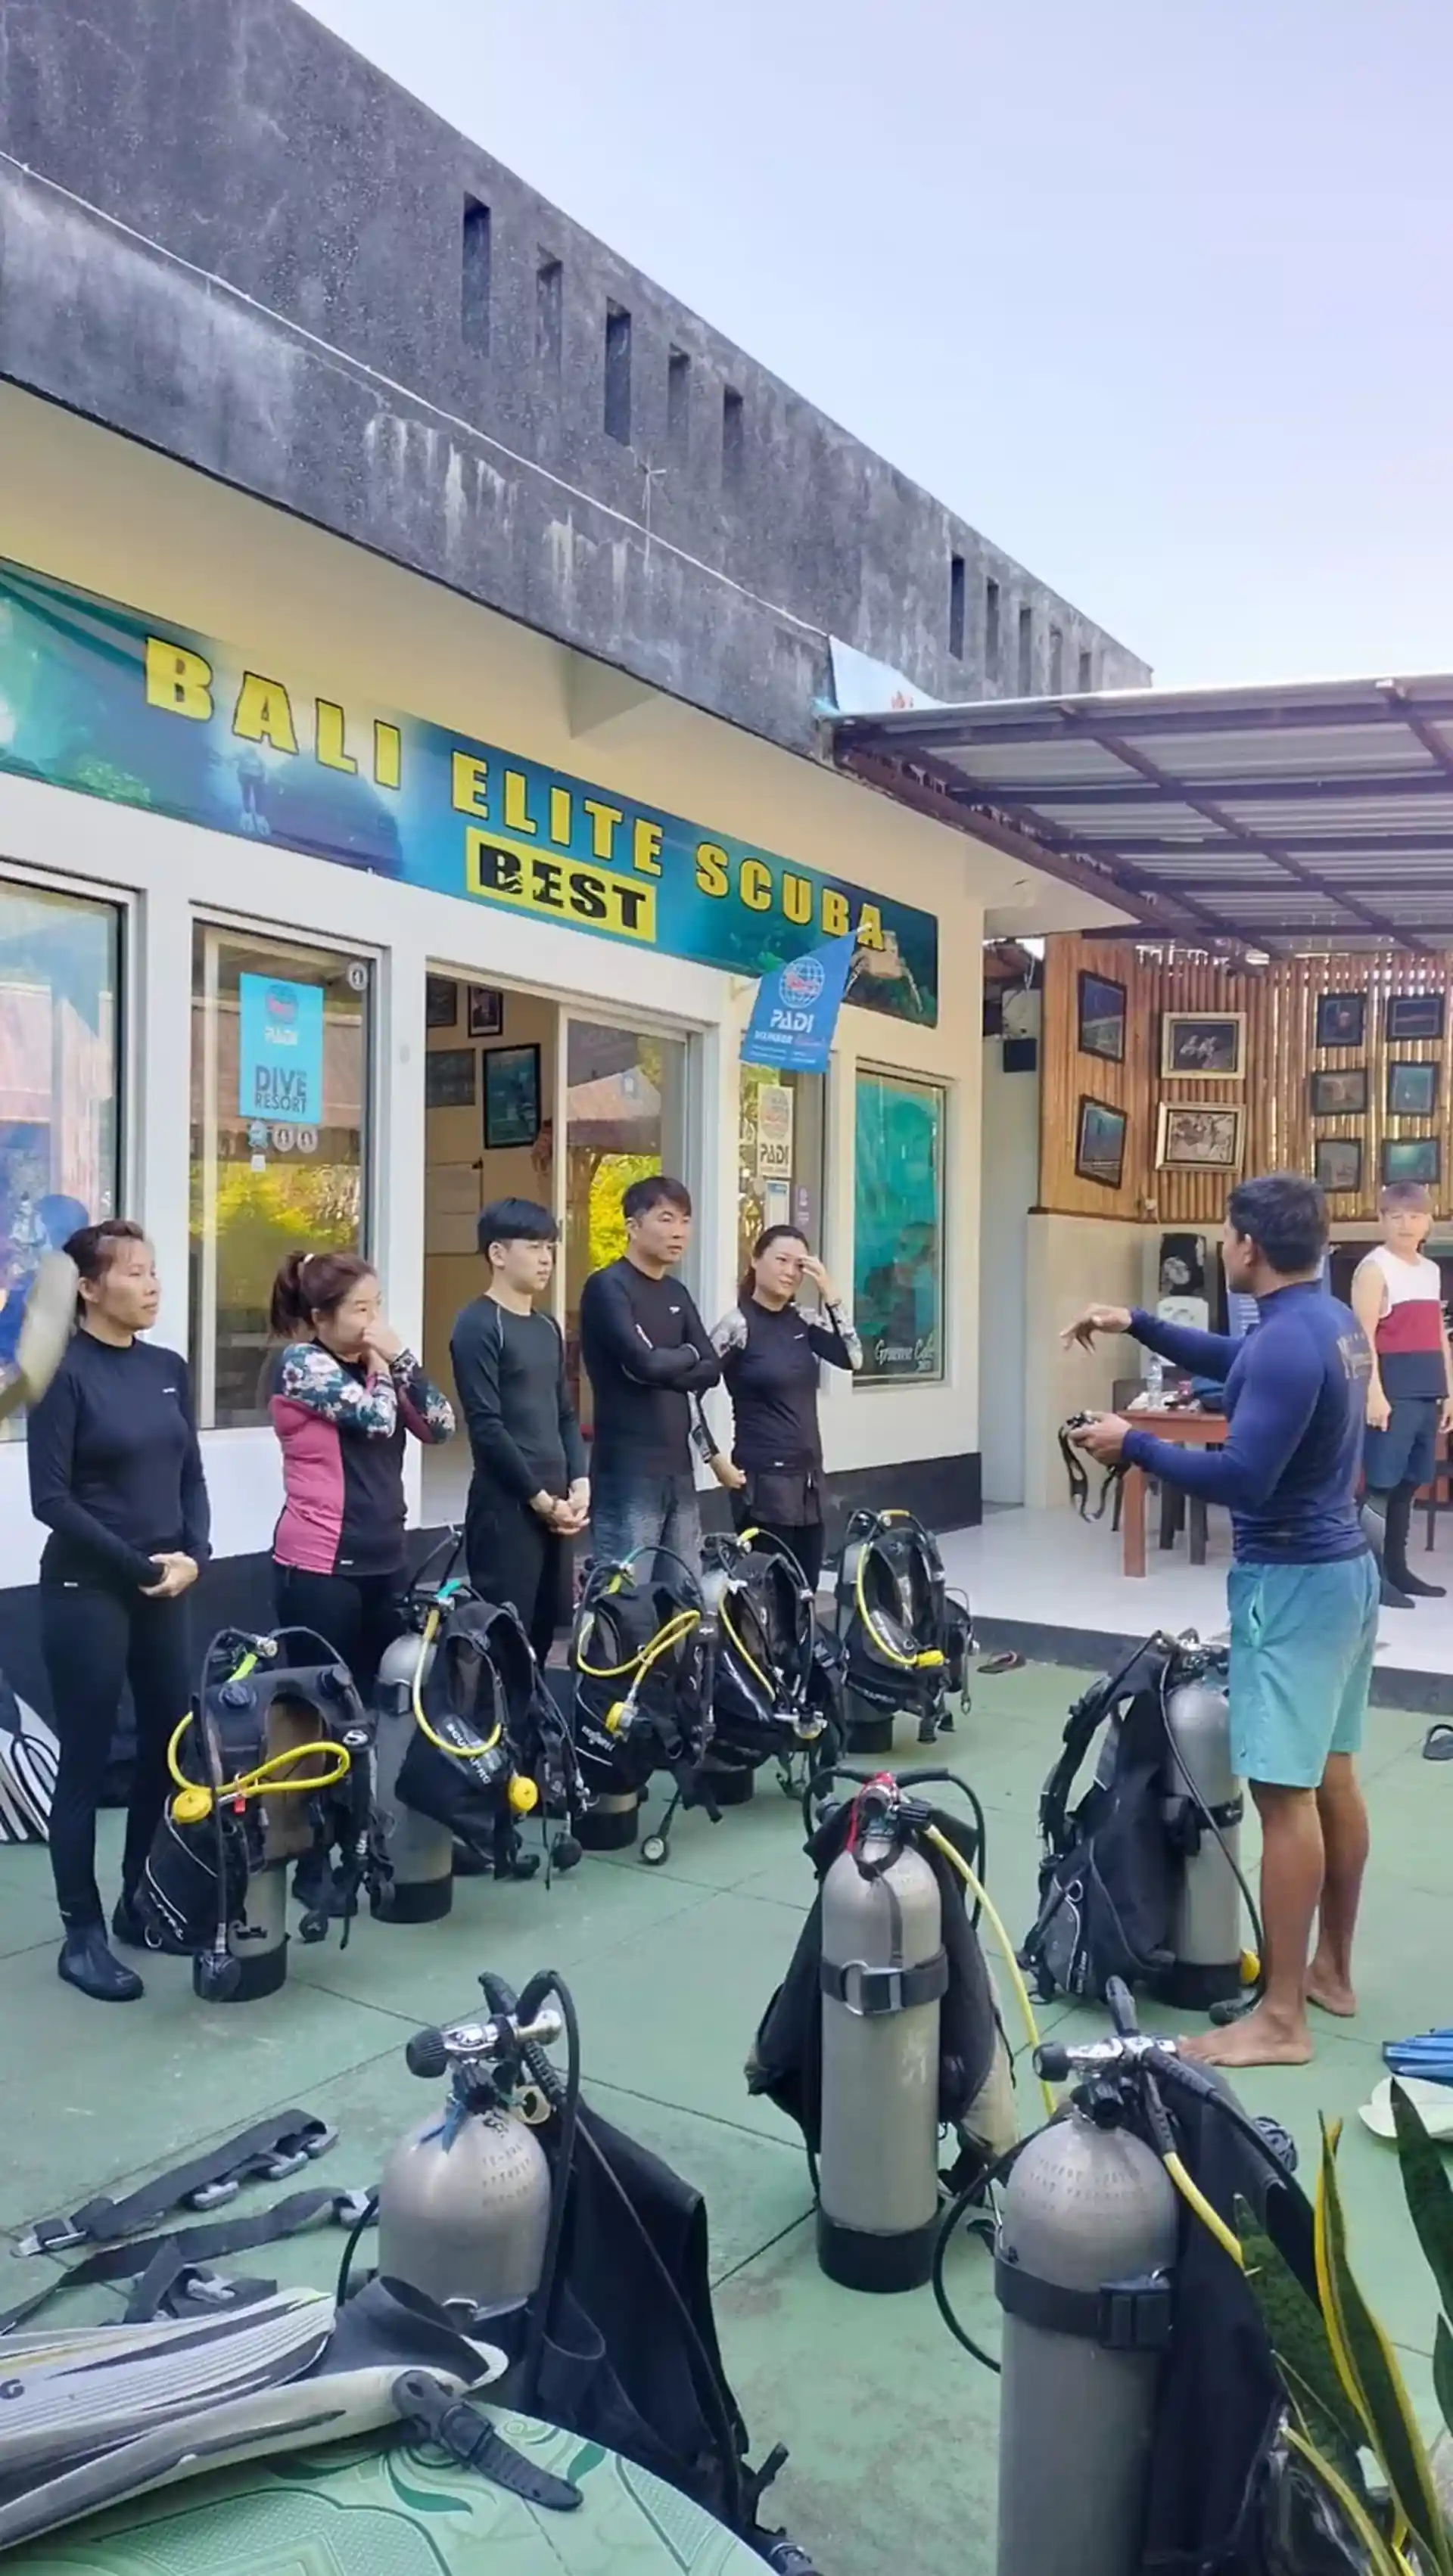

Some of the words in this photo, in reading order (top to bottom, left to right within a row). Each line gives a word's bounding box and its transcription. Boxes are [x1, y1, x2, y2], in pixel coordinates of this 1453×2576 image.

[145, 634, 401, 790] BALI
[451, 749, 663, 877] ELITE
[695, 842, 885, 951] SCUBA
[480, 843, 646, 930] BEST
[770, 1008, 814, 1033] PADI
[255, 1064, 307, 1097] DIVE
[255, 1093, 307, 1114] RESORT
[760, 1143, 789, 1165] PADI
